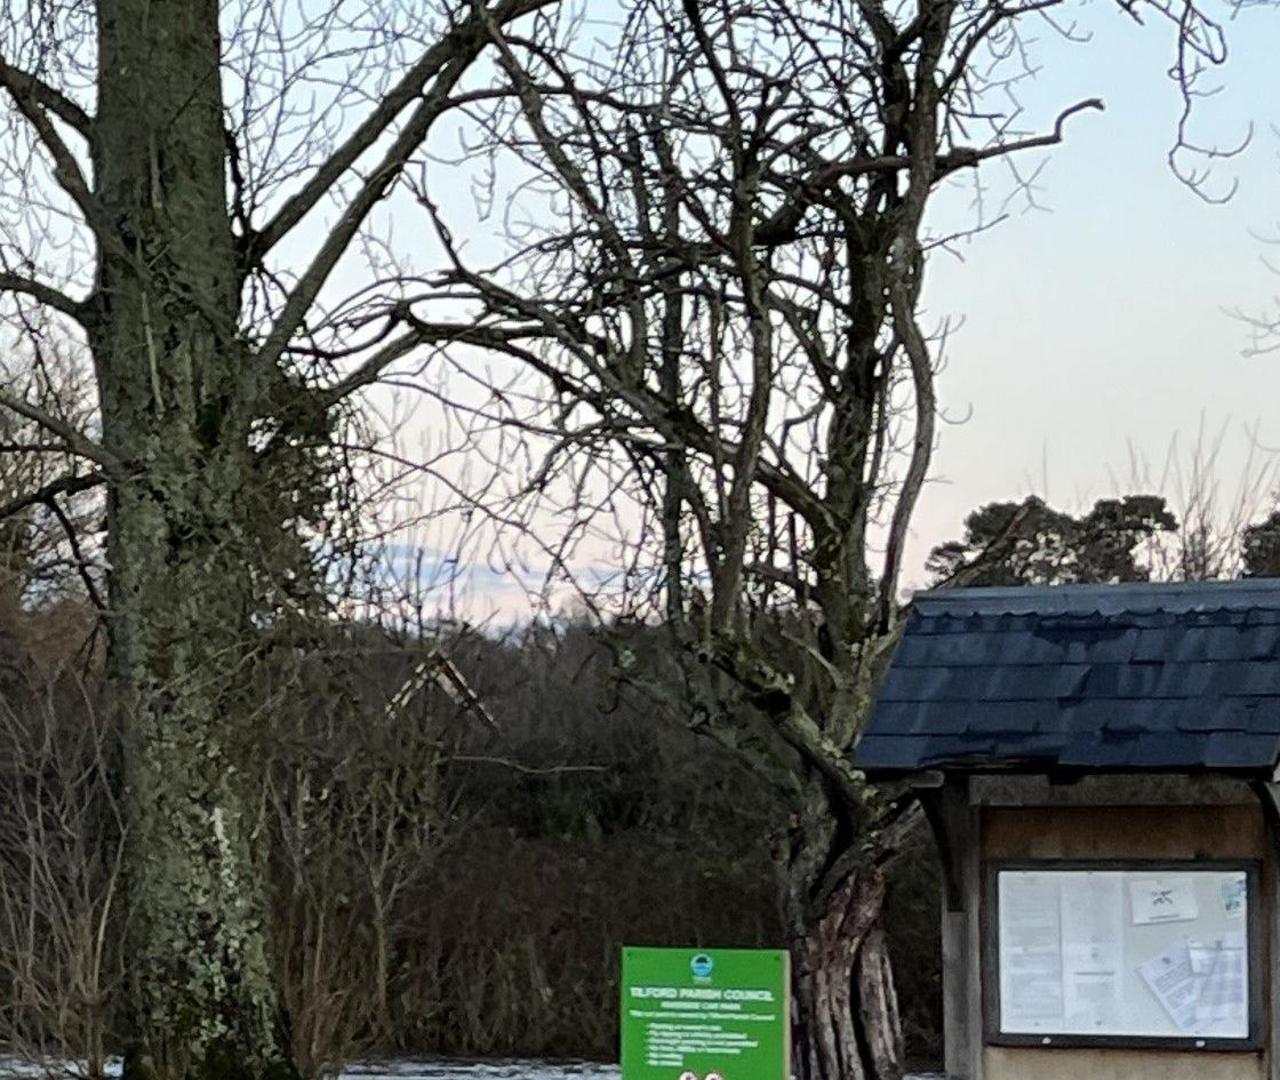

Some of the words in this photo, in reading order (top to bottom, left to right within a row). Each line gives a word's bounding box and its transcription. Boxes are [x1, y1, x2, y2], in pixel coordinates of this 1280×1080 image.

[630, 986, 677, 999] TILFORD
[679, 988, 721, 999] PARISH
[723, 989, 775, 1001] COUNCIL
